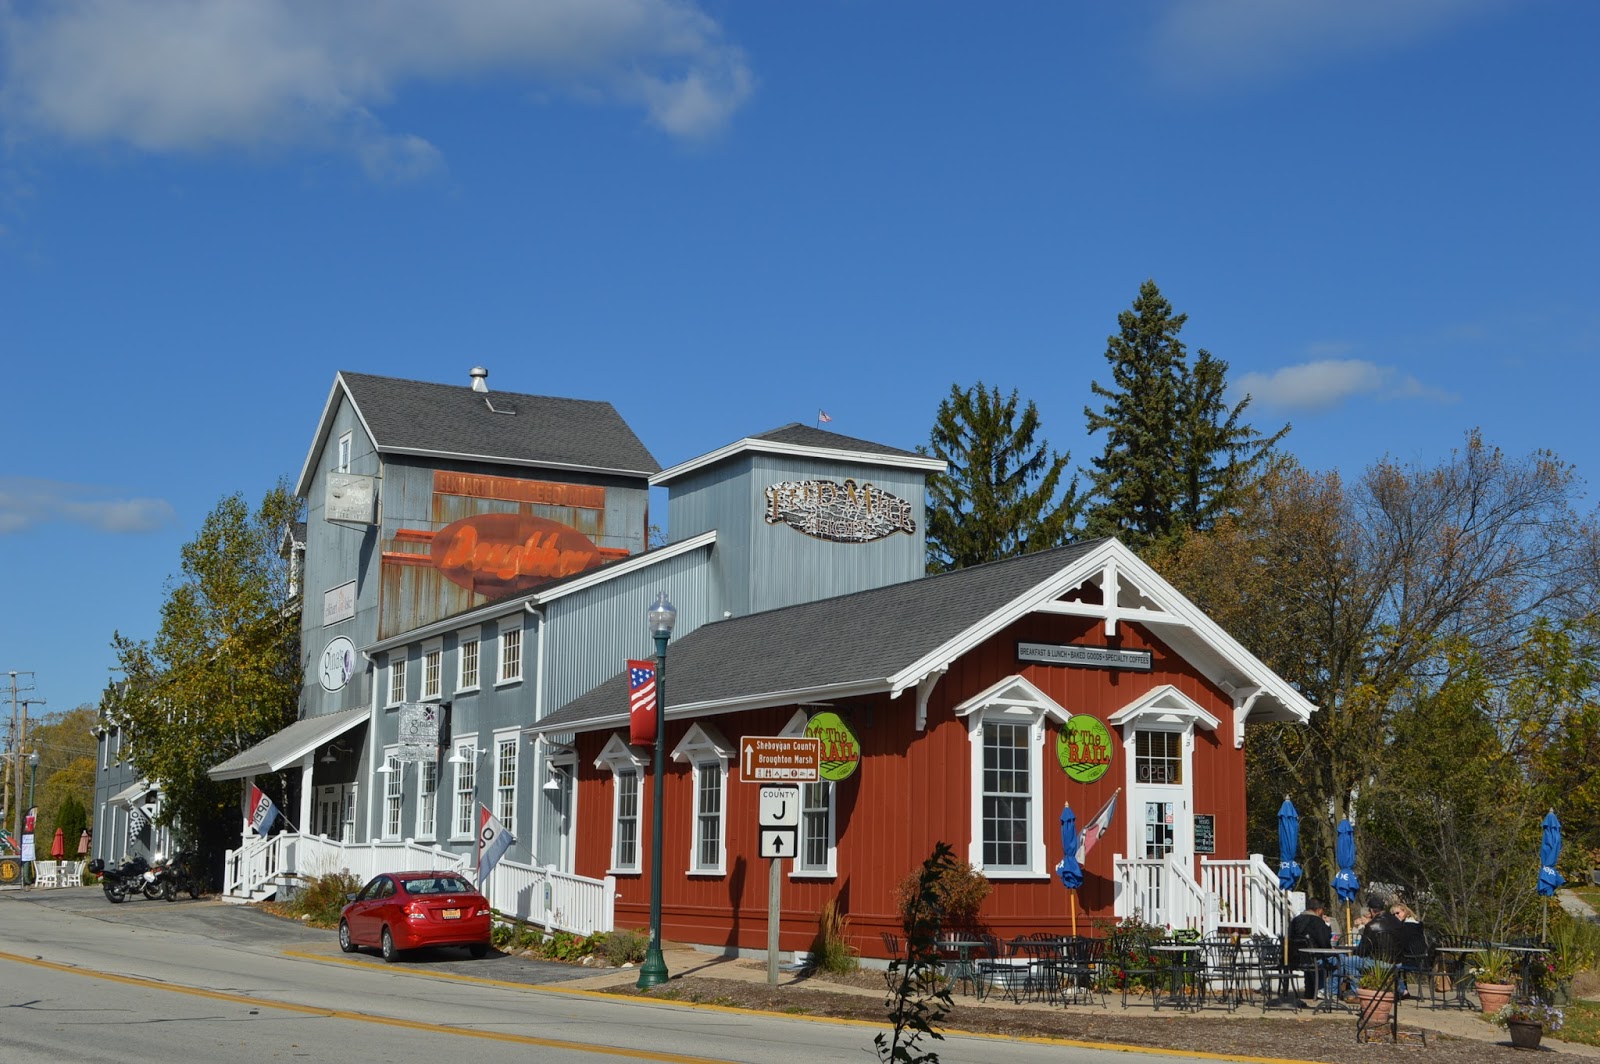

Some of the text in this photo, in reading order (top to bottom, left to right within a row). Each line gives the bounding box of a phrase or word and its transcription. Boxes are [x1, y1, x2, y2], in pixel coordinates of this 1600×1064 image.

[440, 475, 486, 496] ELKHART
[1020, 647, 1047, 657] BREAKFAST
[1052, 650, 1068, 658] LUNCH
[1070, 651, 1086, 660] BAKED
[1087, 652, 1103, 661] GOODS
[1105, 653, 1128, 662] SPECIALTY
[1129, 655, 1149, 664] COFFEES
[826, 727, 847, 743] The
[1061, 729, 1100, 745] Off The
[756, 740, 816, 753] Sheboygan County
[1068, 743, 1110, 764] RAIL
[758, 754, 813, 766] Broughton Marsh
[1141, 766, 1173, 780] OPEN
[763, 791, 795, 799] COUNTY
[772, 800, 786, 820] J
